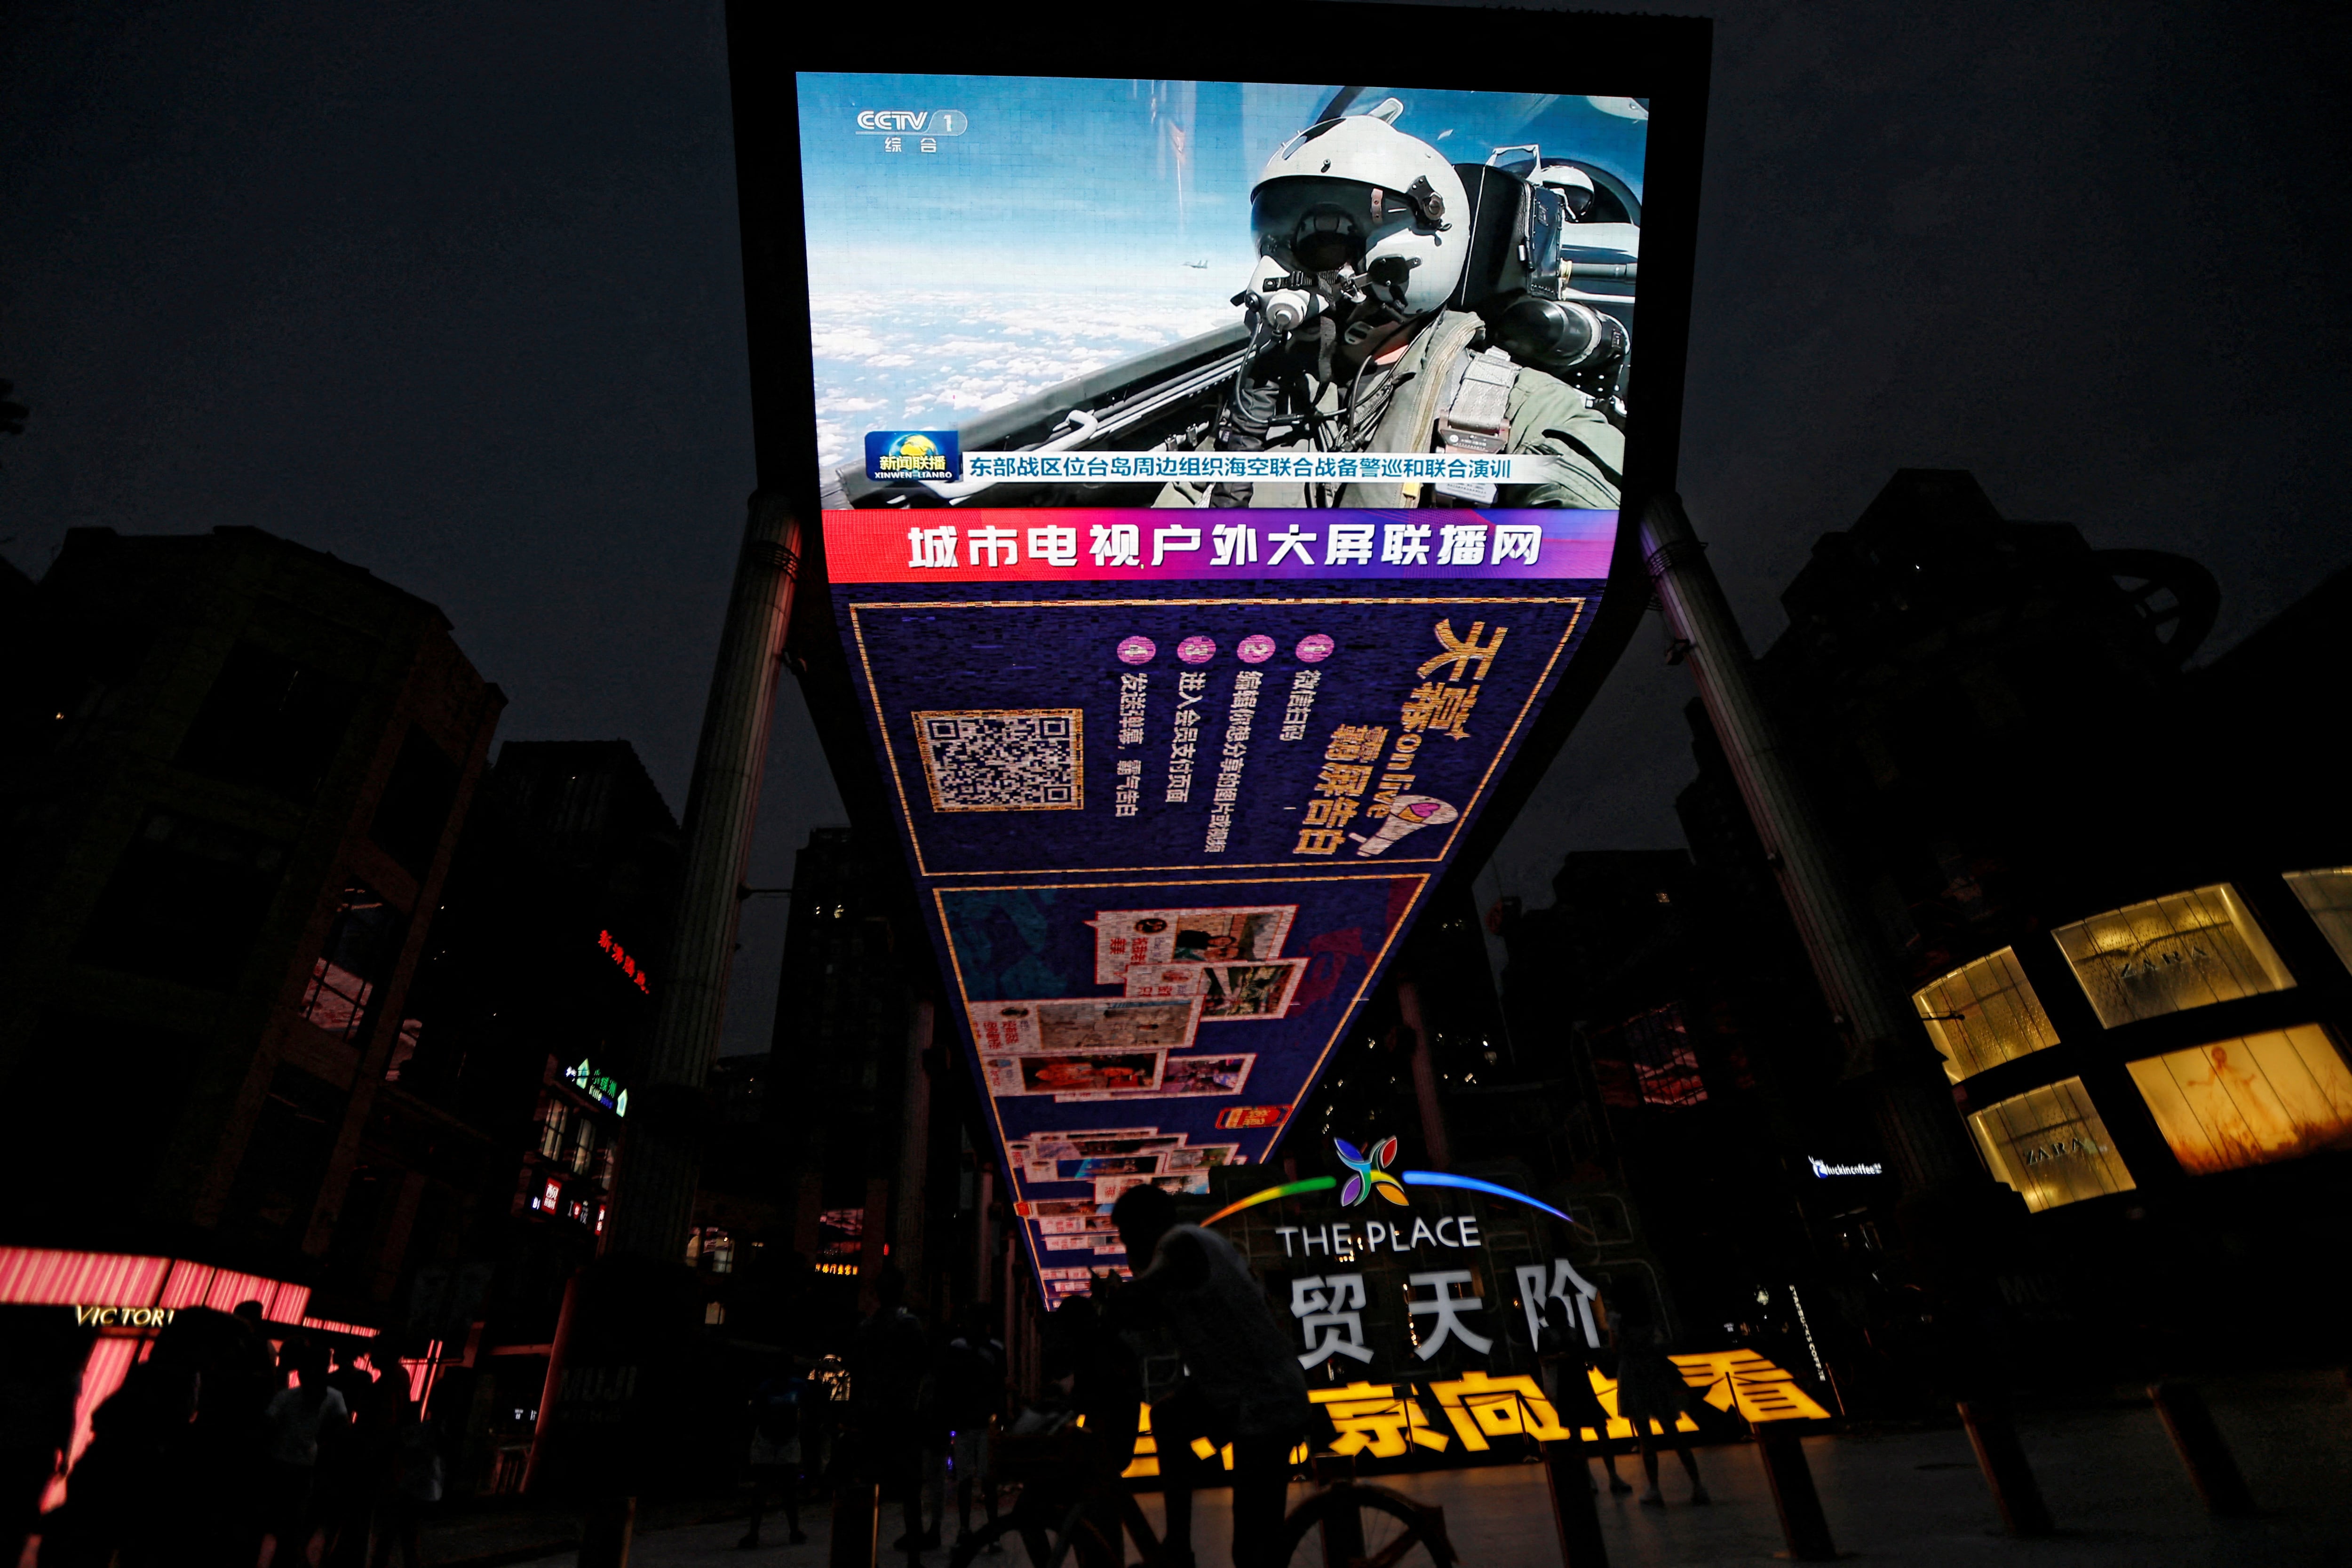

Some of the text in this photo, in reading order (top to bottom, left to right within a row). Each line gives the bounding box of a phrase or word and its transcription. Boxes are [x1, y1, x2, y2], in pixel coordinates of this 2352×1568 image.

[857, 111, 952, 132] CCTV 1
[885, 137, 937, 153] 综合
[880, 455, 946, 471] 新闻联播
[969, 456, 1511, 479] 东部战区位台岛周边组织海空联合战备警巡和联合演训
[907, 523, 1543, 568] 城市电视户外大屏联播网
[1400, 618, 1508, 733] 天幕
[1279, 669, 1322, 742] 微信扫码
[1165, 671, 1207, 803] 进入会员支付页面
[1204, 670, 1264, 853] 编辑你想分享的图片或视频
[2117, 945, 2207, 979] ZARA
[2025, 1138, 2086, 1166] ZARA
[1275, 1216, 1481, 1258] THE PLACE
